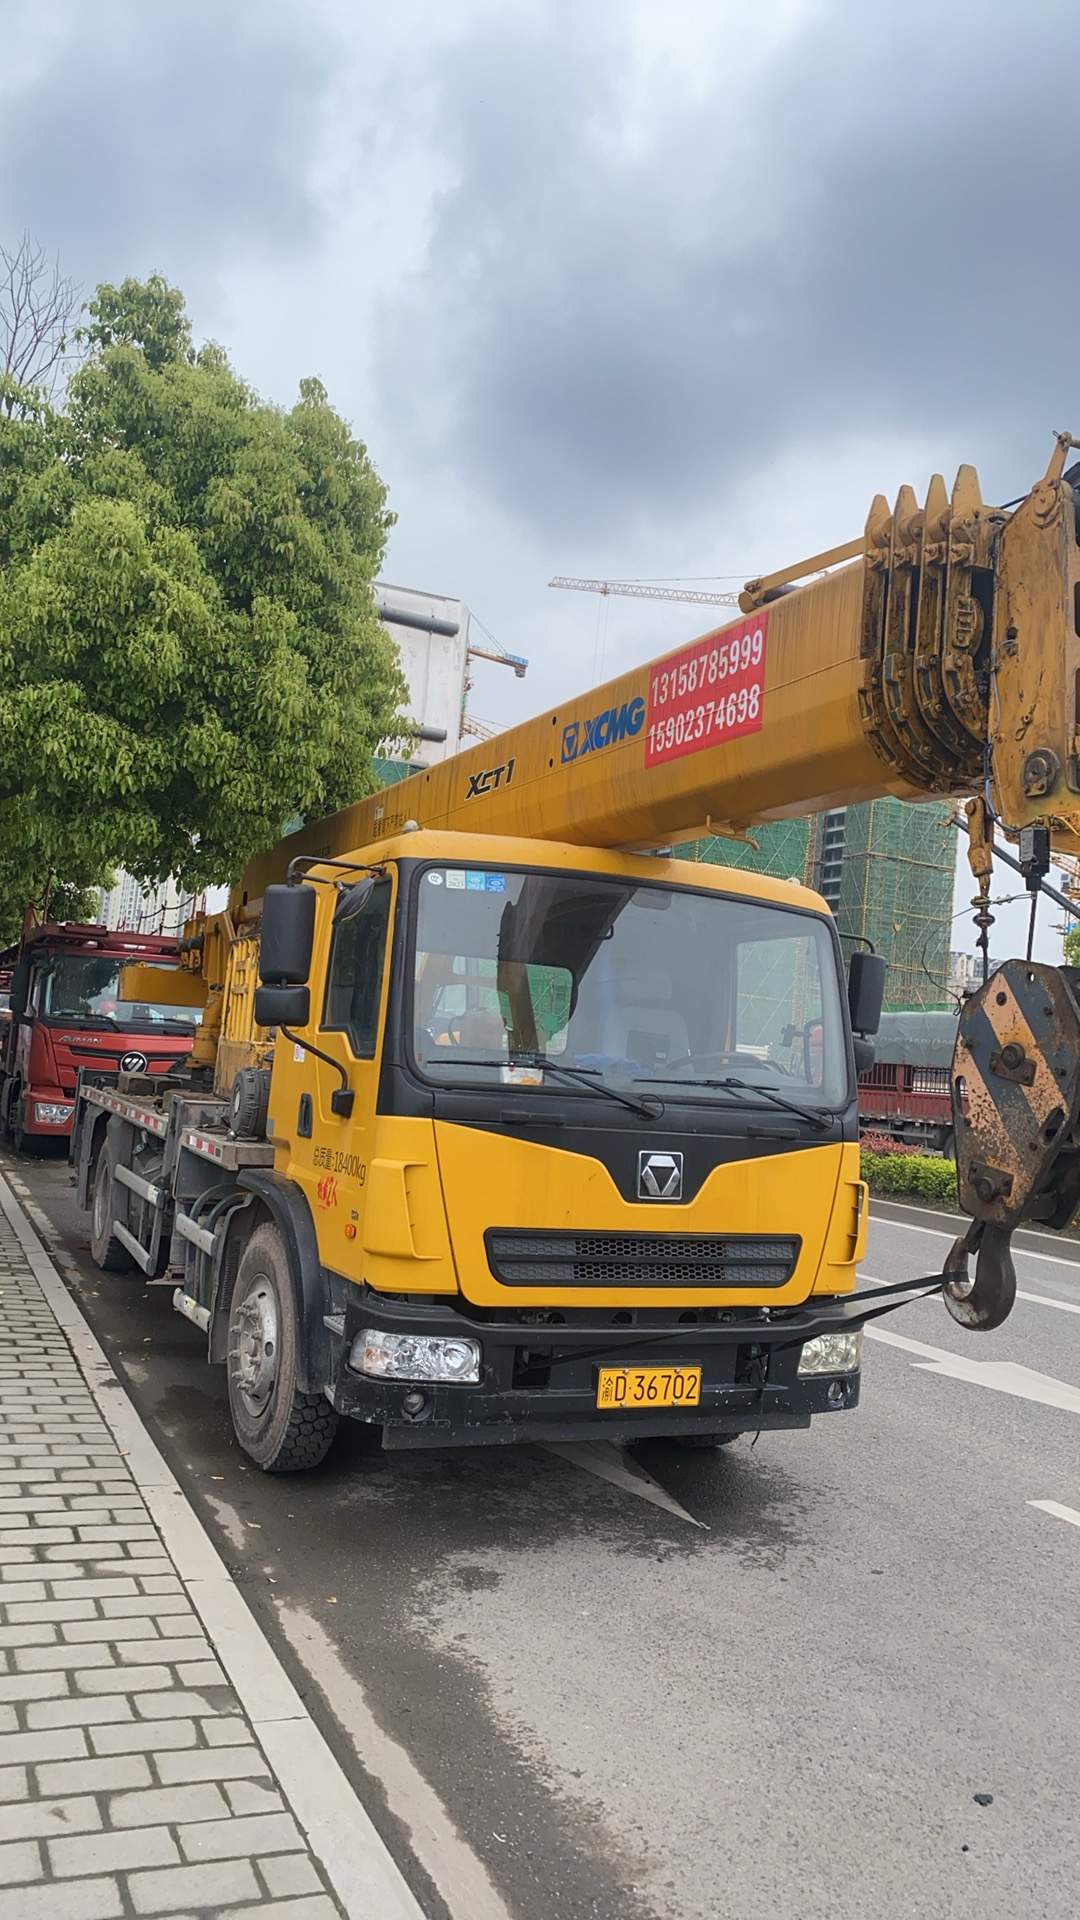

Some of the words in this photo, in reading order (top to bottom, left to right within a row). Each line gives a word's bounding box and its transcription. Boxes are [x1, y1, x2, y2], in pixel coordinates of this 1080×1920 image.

[652, 629, 763, 707] 13158785999
[579, 697, 645, 756] XCMG
[649, 684, 760, 755] 15902374698
[465, 757, 516, 800] XCT1
